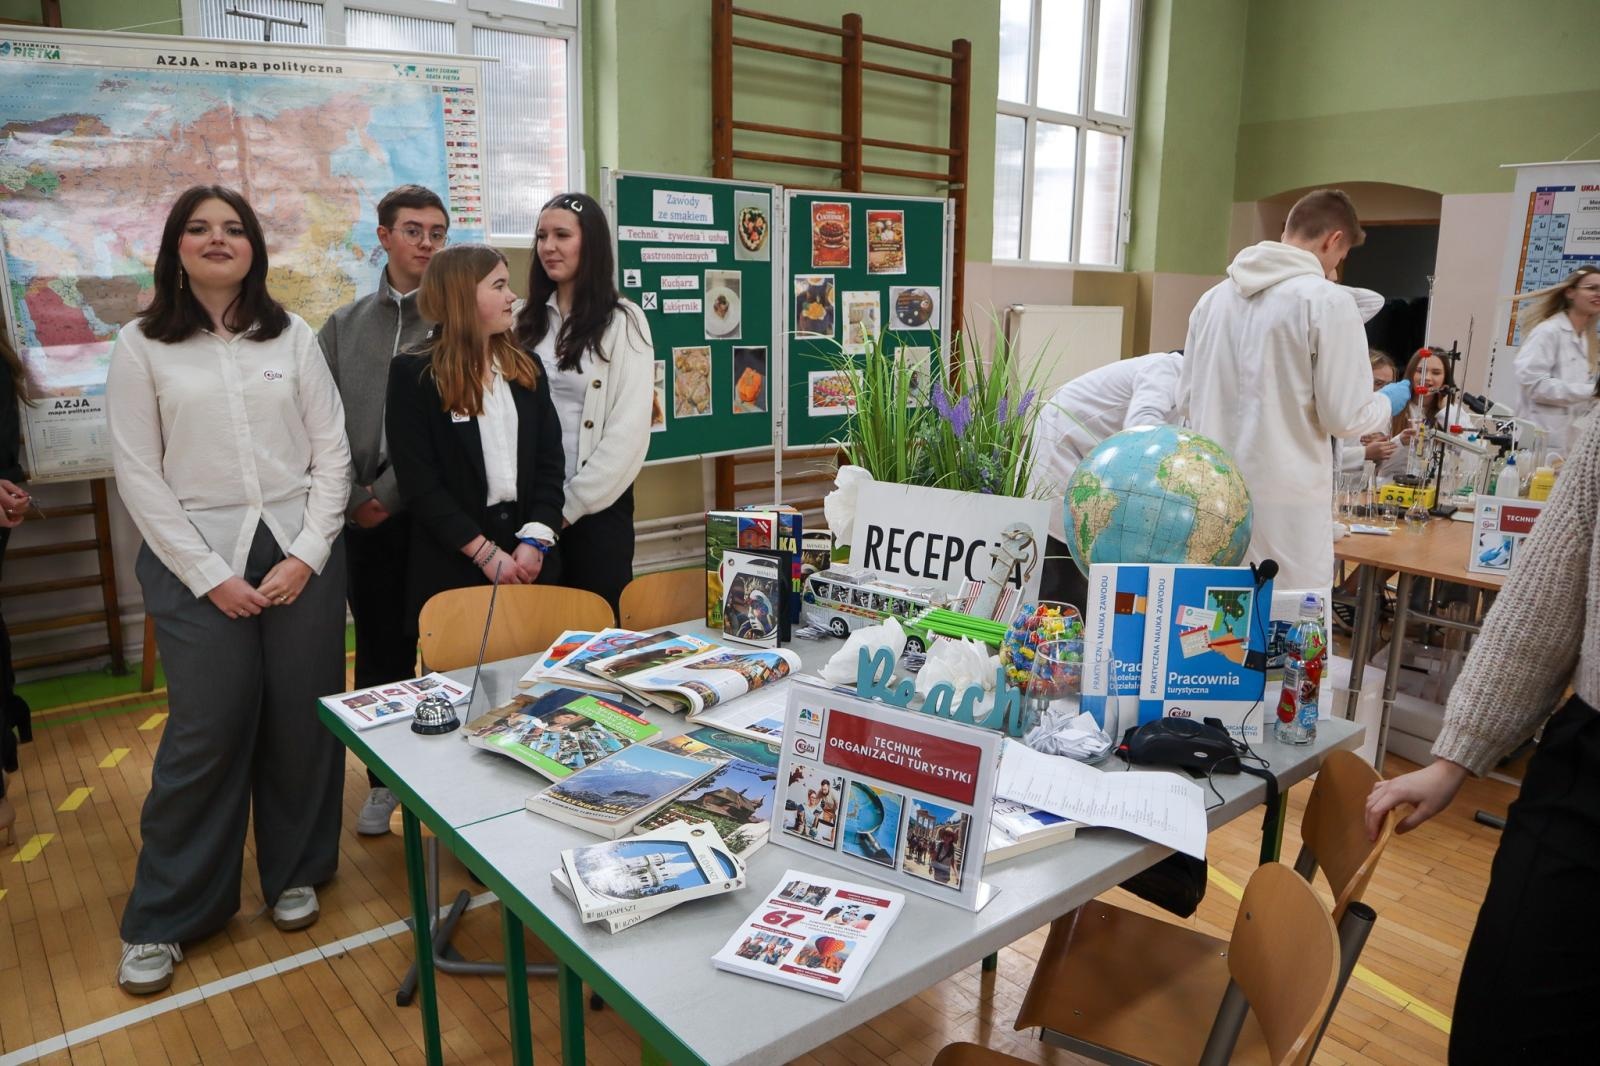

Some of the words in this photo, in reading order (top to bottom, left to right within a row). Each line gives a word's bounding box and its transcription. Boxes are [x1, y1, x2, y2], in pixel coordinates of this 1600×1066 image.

[156, 55, 200, 67] AZJA
[215, 58, 257, 71] mapa
[263, 61, 343, 74] polityczna
[667, 194, 700, 208] Zawody
[670, 211, 708, 222] smakiem
[627, 229, 659, 239] Technik
[643, 251, 709, 263] gastronomicznych
[662, 279, 694, 288] Kucharz
[54, 398, 90, 409] AZJA
[1506, 514, 1536, 523] TECHNI
[1099, 576, 1109, 611] ZAWODU
[1157, 578, 1166, 613] ZAWODU
[1097, 613, 1106, 639] NAUKA
[1154, 616, 1163, 643] NAUKA
[1111, 660, 1142, 672] Prac
[1150, 645, 1161, 694] PRAKTYCZNA
[1168, 671, 1240, 686] Pracownia
[856, 644, 1022, 738] Beach
[1167, 686, 1209, 696] turystyczna
[874, 736, 923, 758] TECHNIK
[829, 737, 904, 766] ORGANIZACJI
[908, 757, 972, 784] TURYSTYKI
[597, 904, 637, 918] BUDAPESZT
[762, 910, 805, 929] 67
